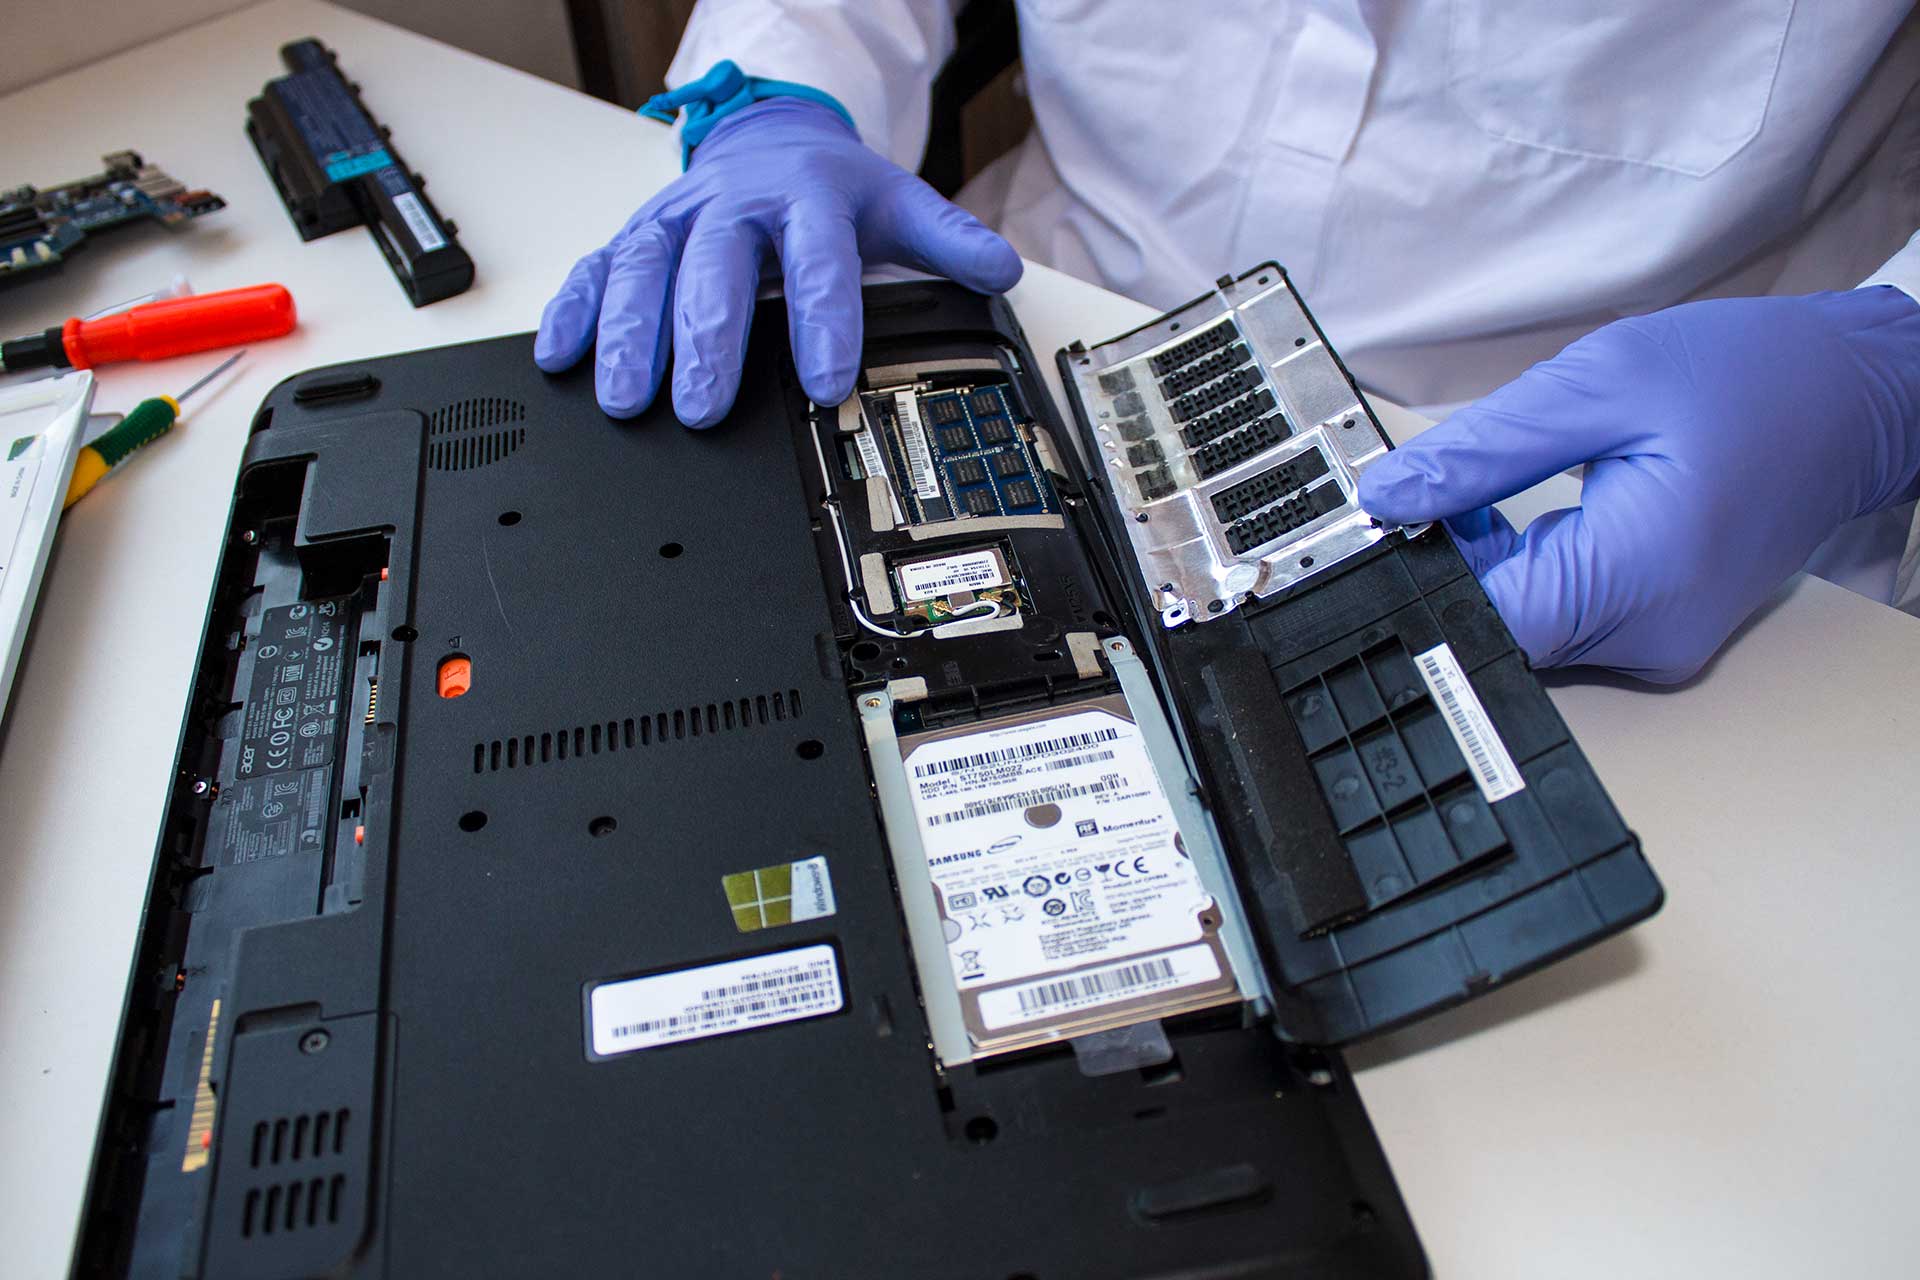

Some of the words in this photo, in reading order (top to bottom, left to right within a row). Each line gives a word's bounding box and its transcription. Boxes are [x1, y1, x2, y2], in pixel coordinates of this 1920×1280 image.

[240, 744, 256, 774] acer
[919, 777, 950, 790] Model
[959, 764, 1023, 782] ST750LM022
[928, 849, 982, 867] SAMSUNG
